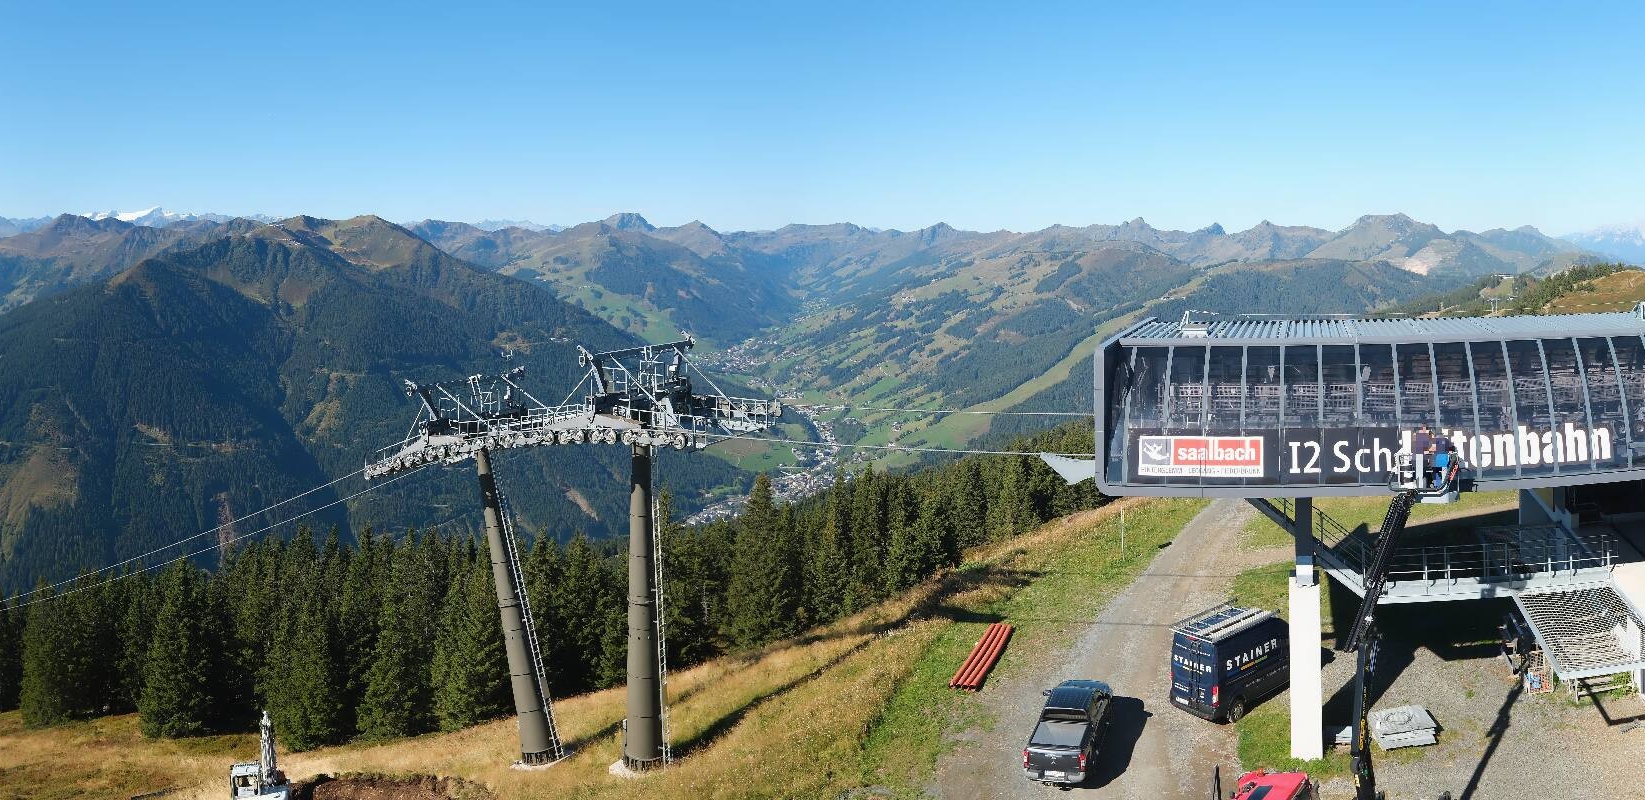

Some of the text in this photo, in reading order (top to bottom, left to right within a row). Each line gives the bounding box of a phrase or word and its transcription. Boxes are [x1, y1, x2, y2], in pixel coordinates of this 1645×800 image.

[1177, 439, 1256, 461] saalbach
[1173, 654, 1212, 673] STAINER
[1226, 638, 1278, 671] STAINER
